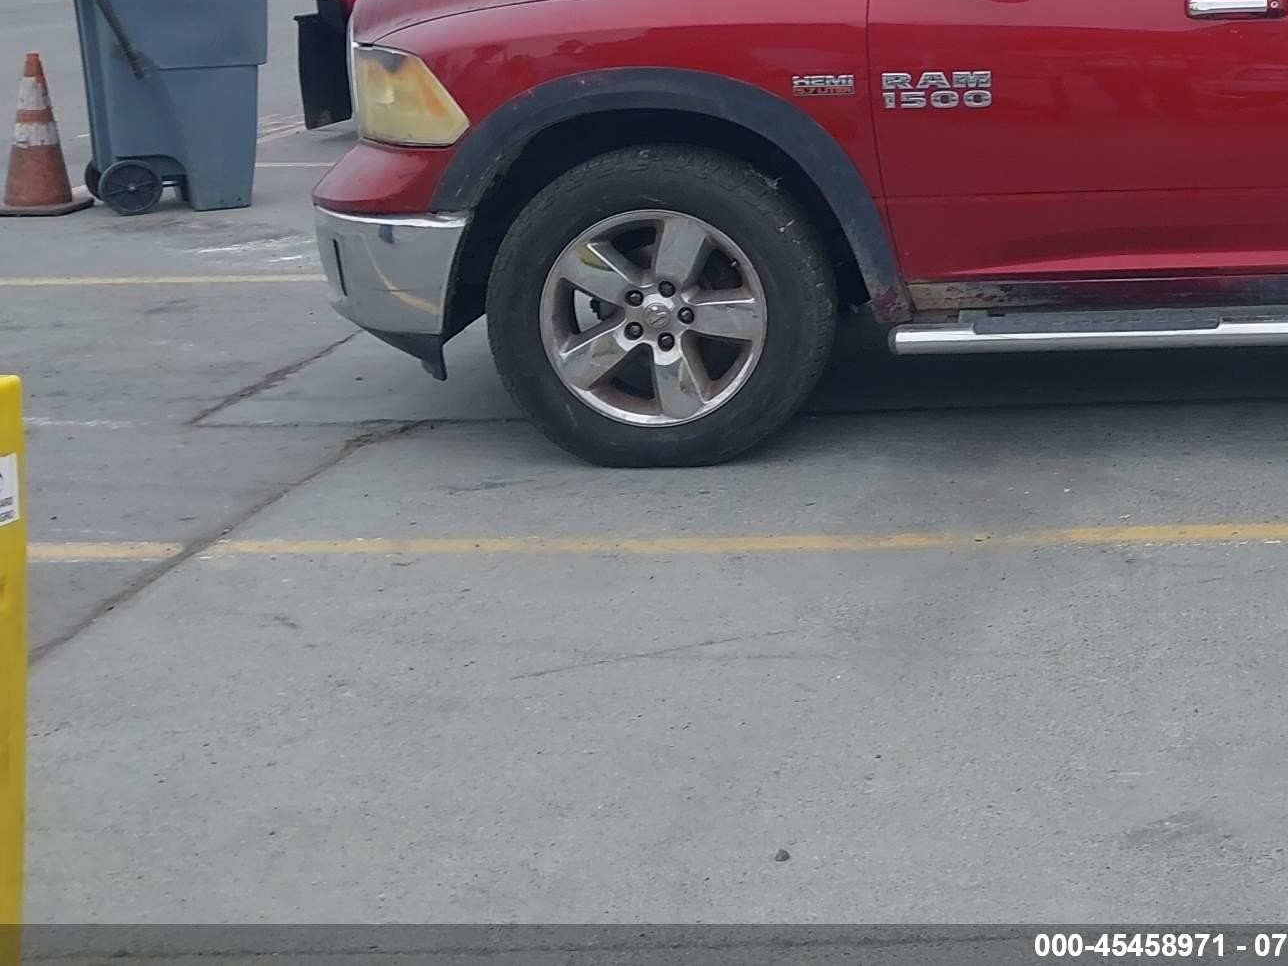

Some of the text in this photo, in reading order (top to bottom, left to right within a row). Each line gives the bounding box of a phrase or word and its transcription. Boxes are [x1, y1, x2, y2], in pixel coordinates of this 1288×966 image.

[792, 74, 854, 86] HEMI
[881, 71, 992, 89] RAM
[882, 90, 992, 109] 1500
